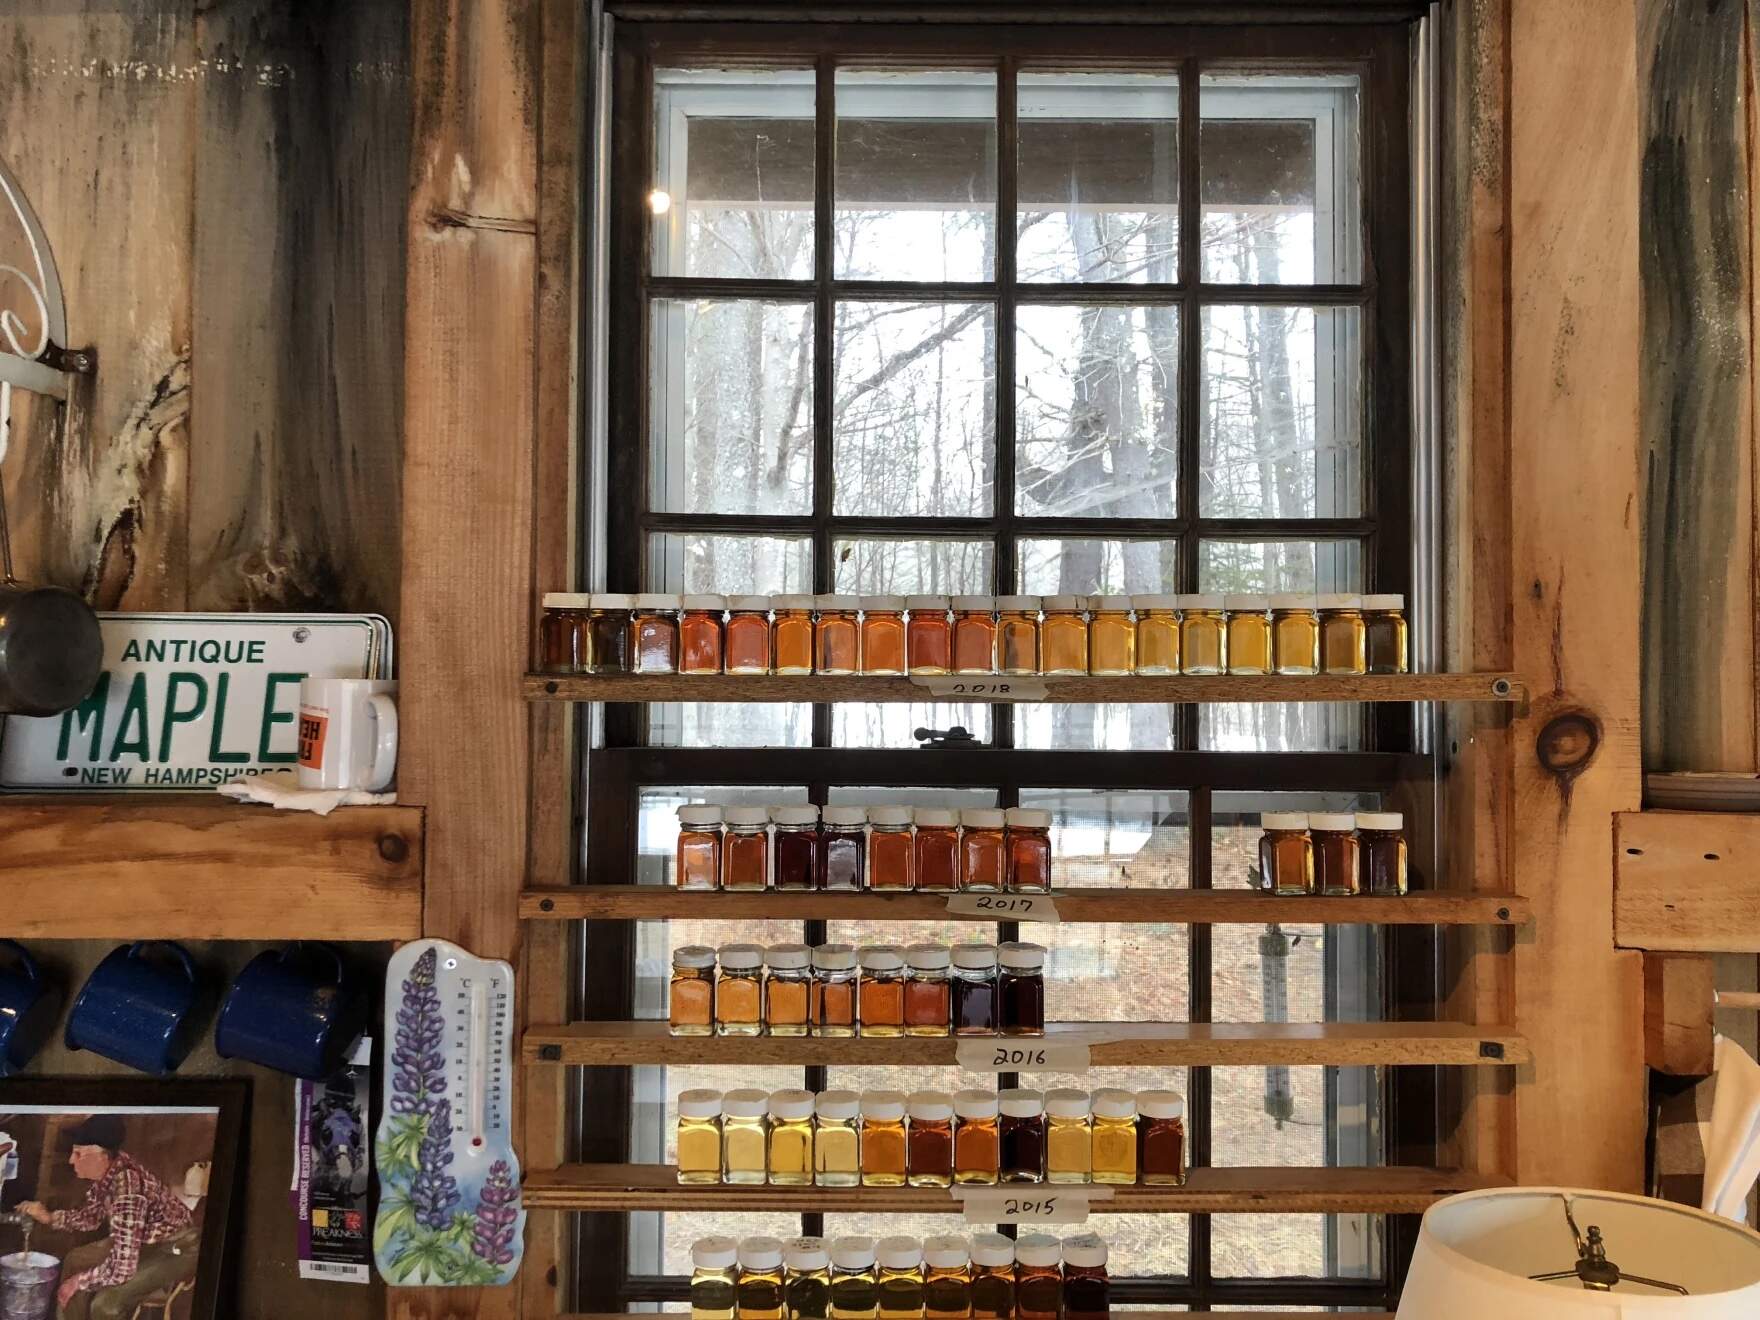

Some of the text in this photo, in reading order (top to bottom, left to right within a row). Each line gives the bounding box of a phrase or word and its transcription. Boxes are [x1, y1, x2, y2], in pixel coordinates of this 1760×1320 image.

[121, 639, 266, 664] ANTIQUE
[952, 684, 1011, 693] 2018
[56, 671, 309, 763] MAPLE
[81, 767, 292, 785] NEW HAMPSHR
[976, 896, 1033, 912] 2017
[992, 1047, 1046, 1066] 2016
[301, 1144, 311, 1178] RESERVED
[1004, 1197, 1058, 1215] 2015
